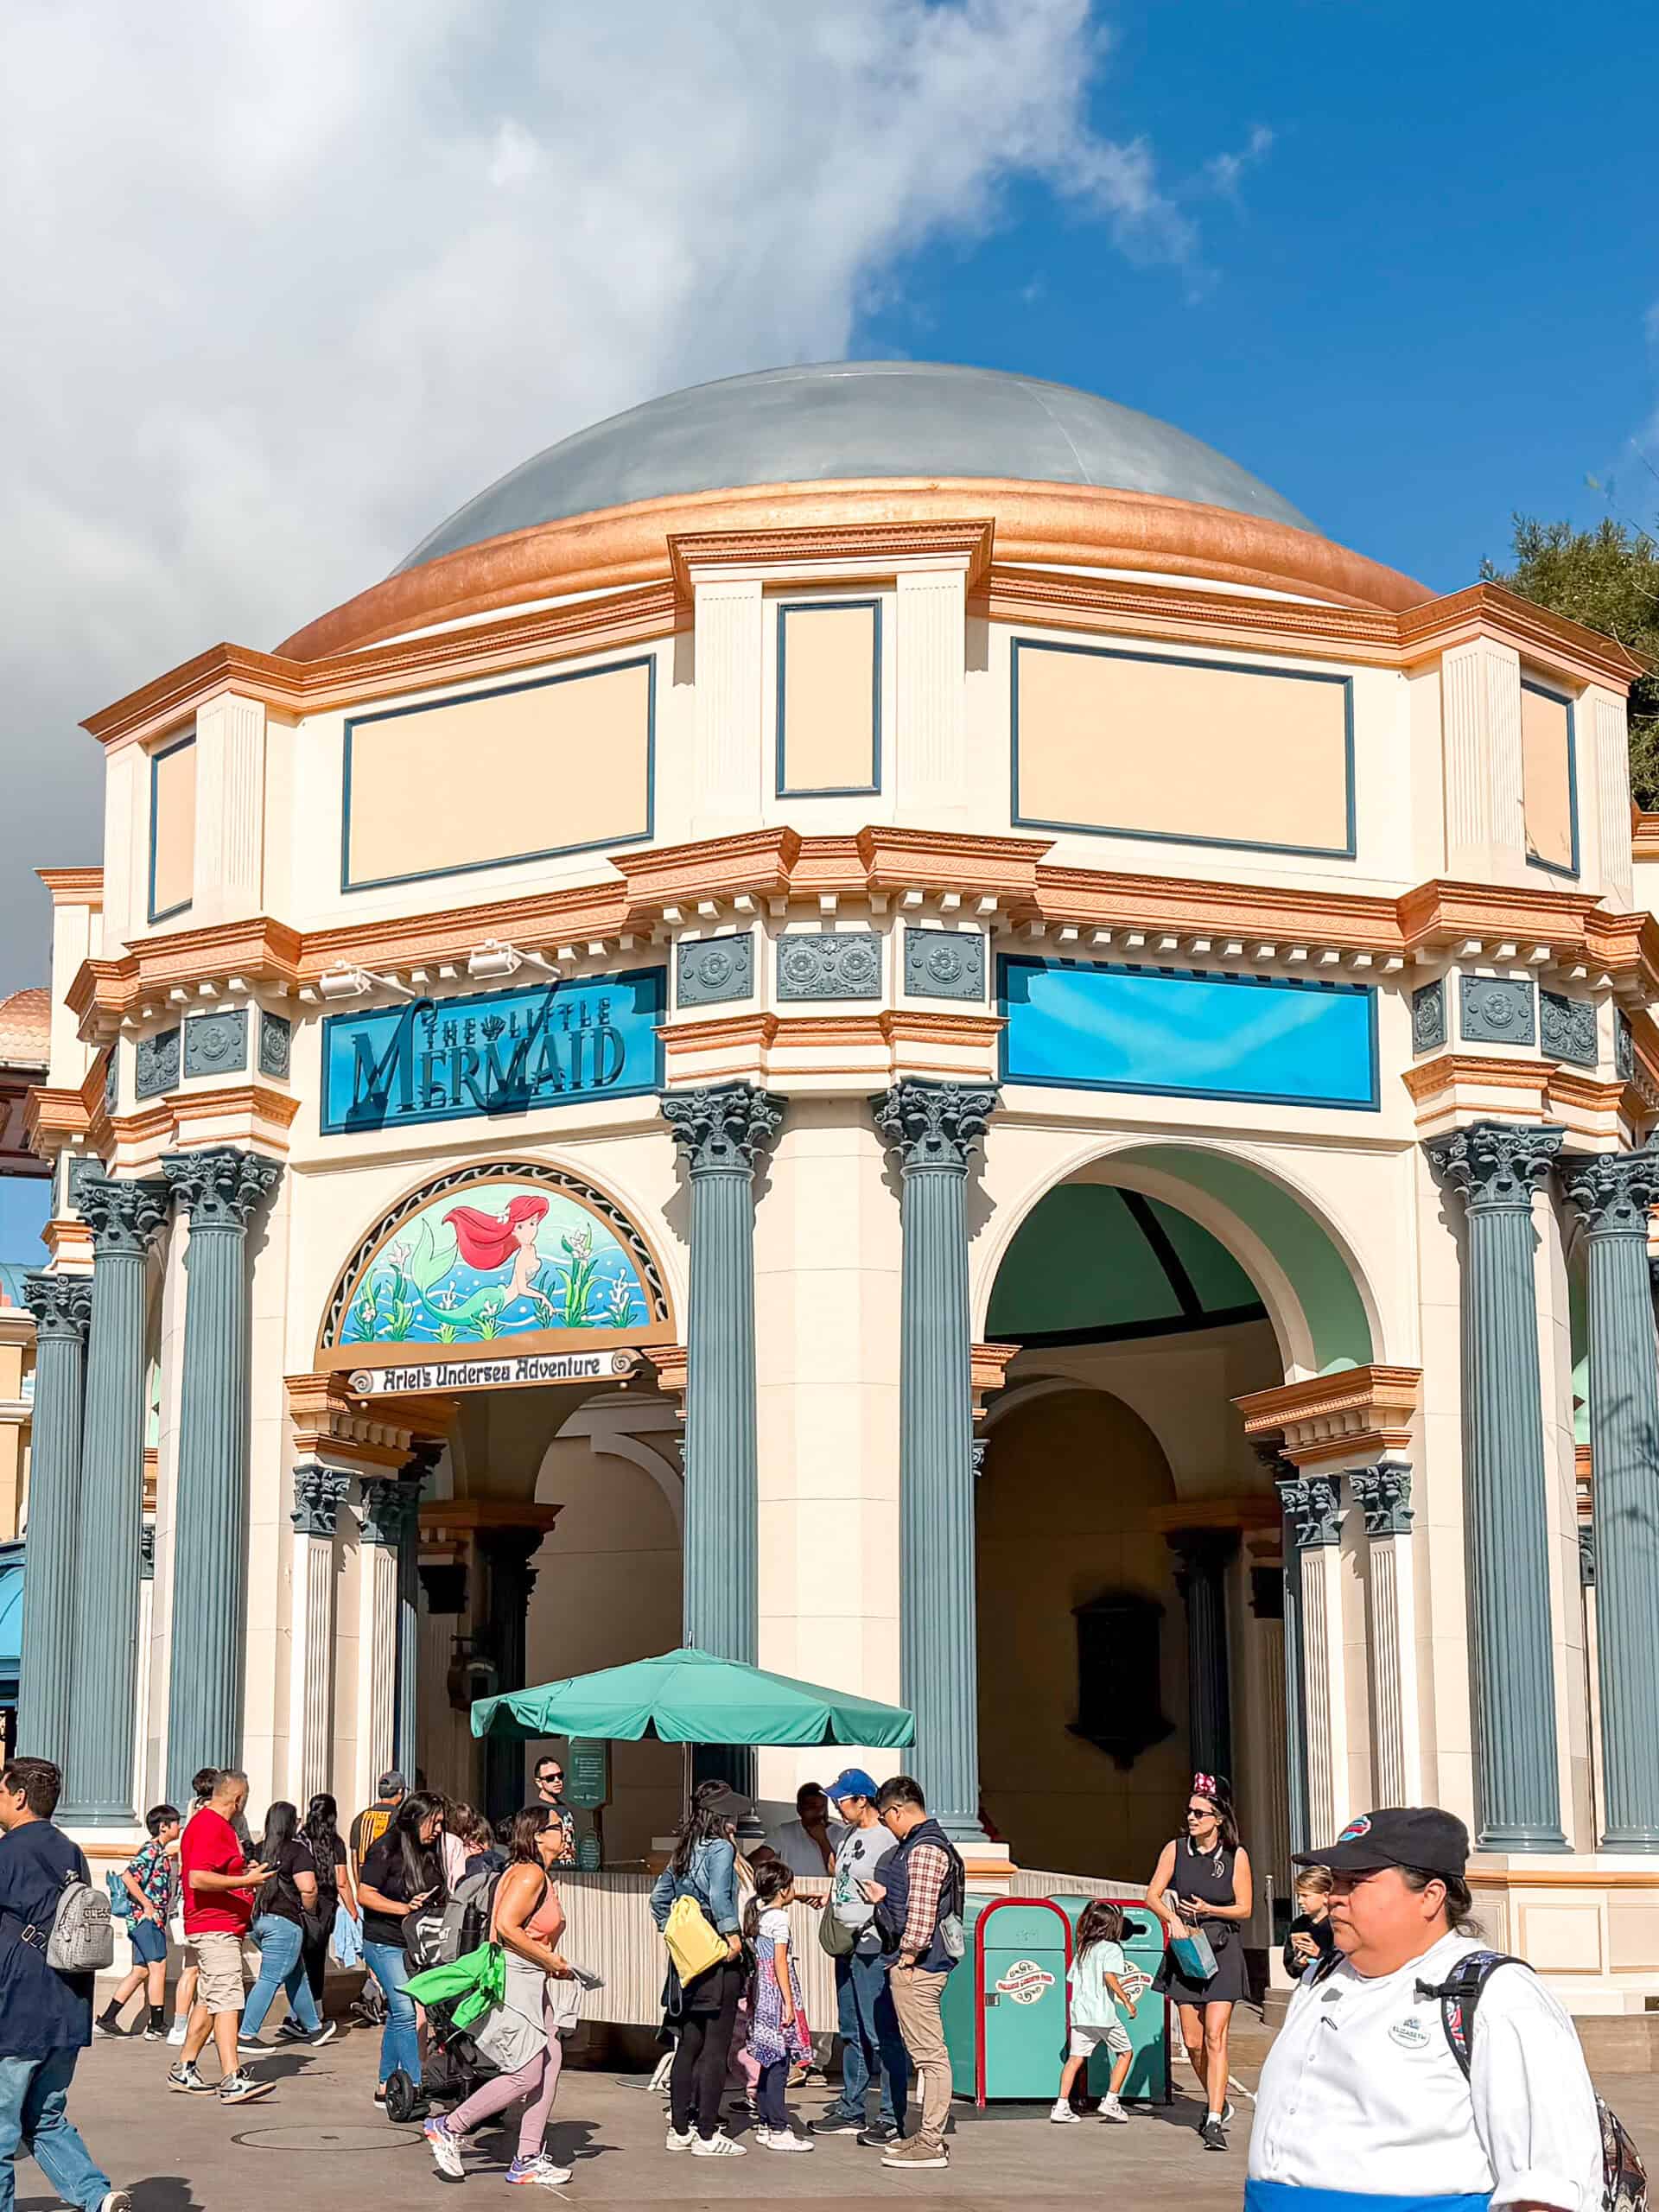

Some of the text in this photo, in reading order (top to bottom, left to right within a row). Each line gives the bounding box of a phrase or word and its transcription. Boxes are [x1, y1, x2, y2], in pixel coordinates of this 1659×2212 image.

[422, 997, 611, 1050] THE LITTLE
[347, 997, 626, 1116] MERMAID
[383, 1356, 601, 1391] Ariel's Undersea Adventure
